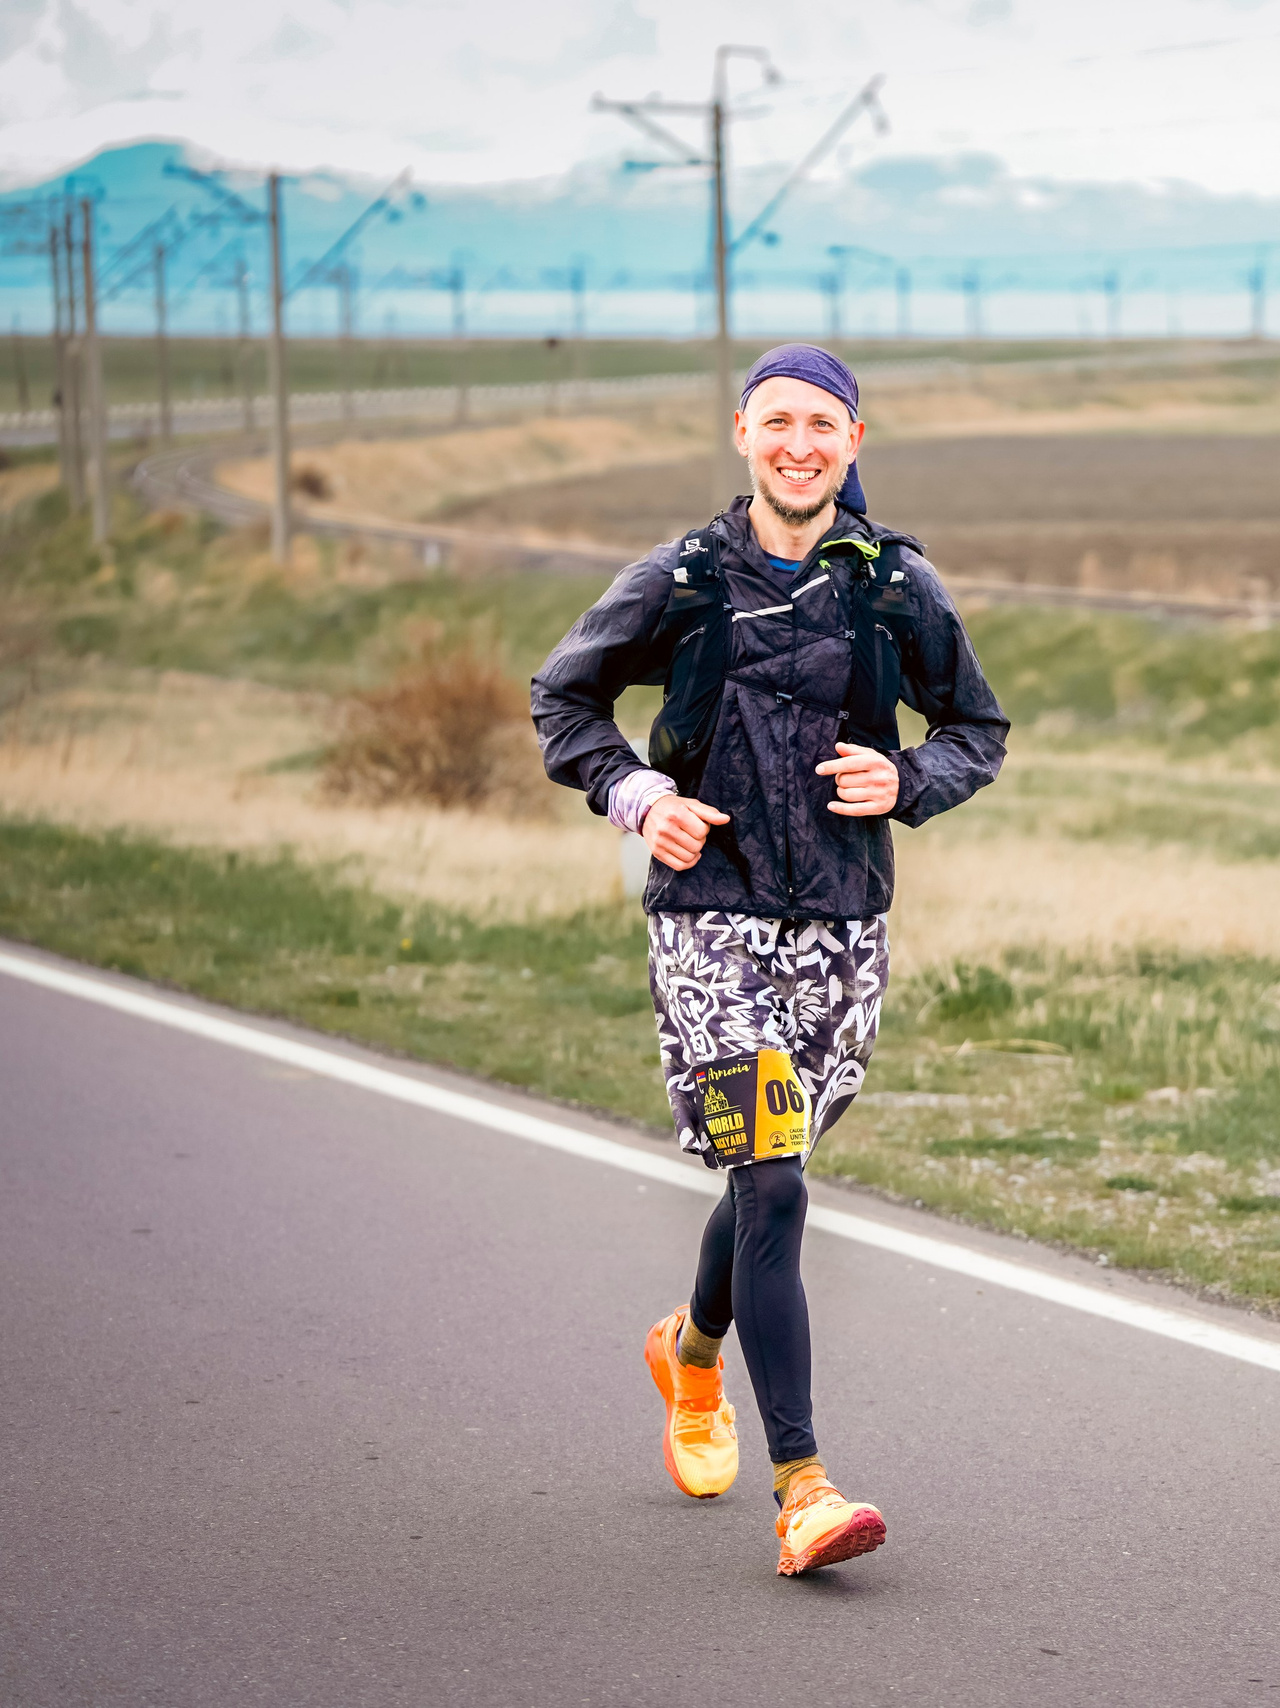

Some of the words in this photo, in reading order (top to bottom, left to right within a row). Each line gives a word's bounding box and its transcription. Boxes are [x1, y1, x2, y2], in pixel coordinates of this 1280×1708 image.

[708, 1063, 751, 1082] Armenia
[765, 1079, 805, 1116] 06
[706, 1112, 745, 1135] WORLD
